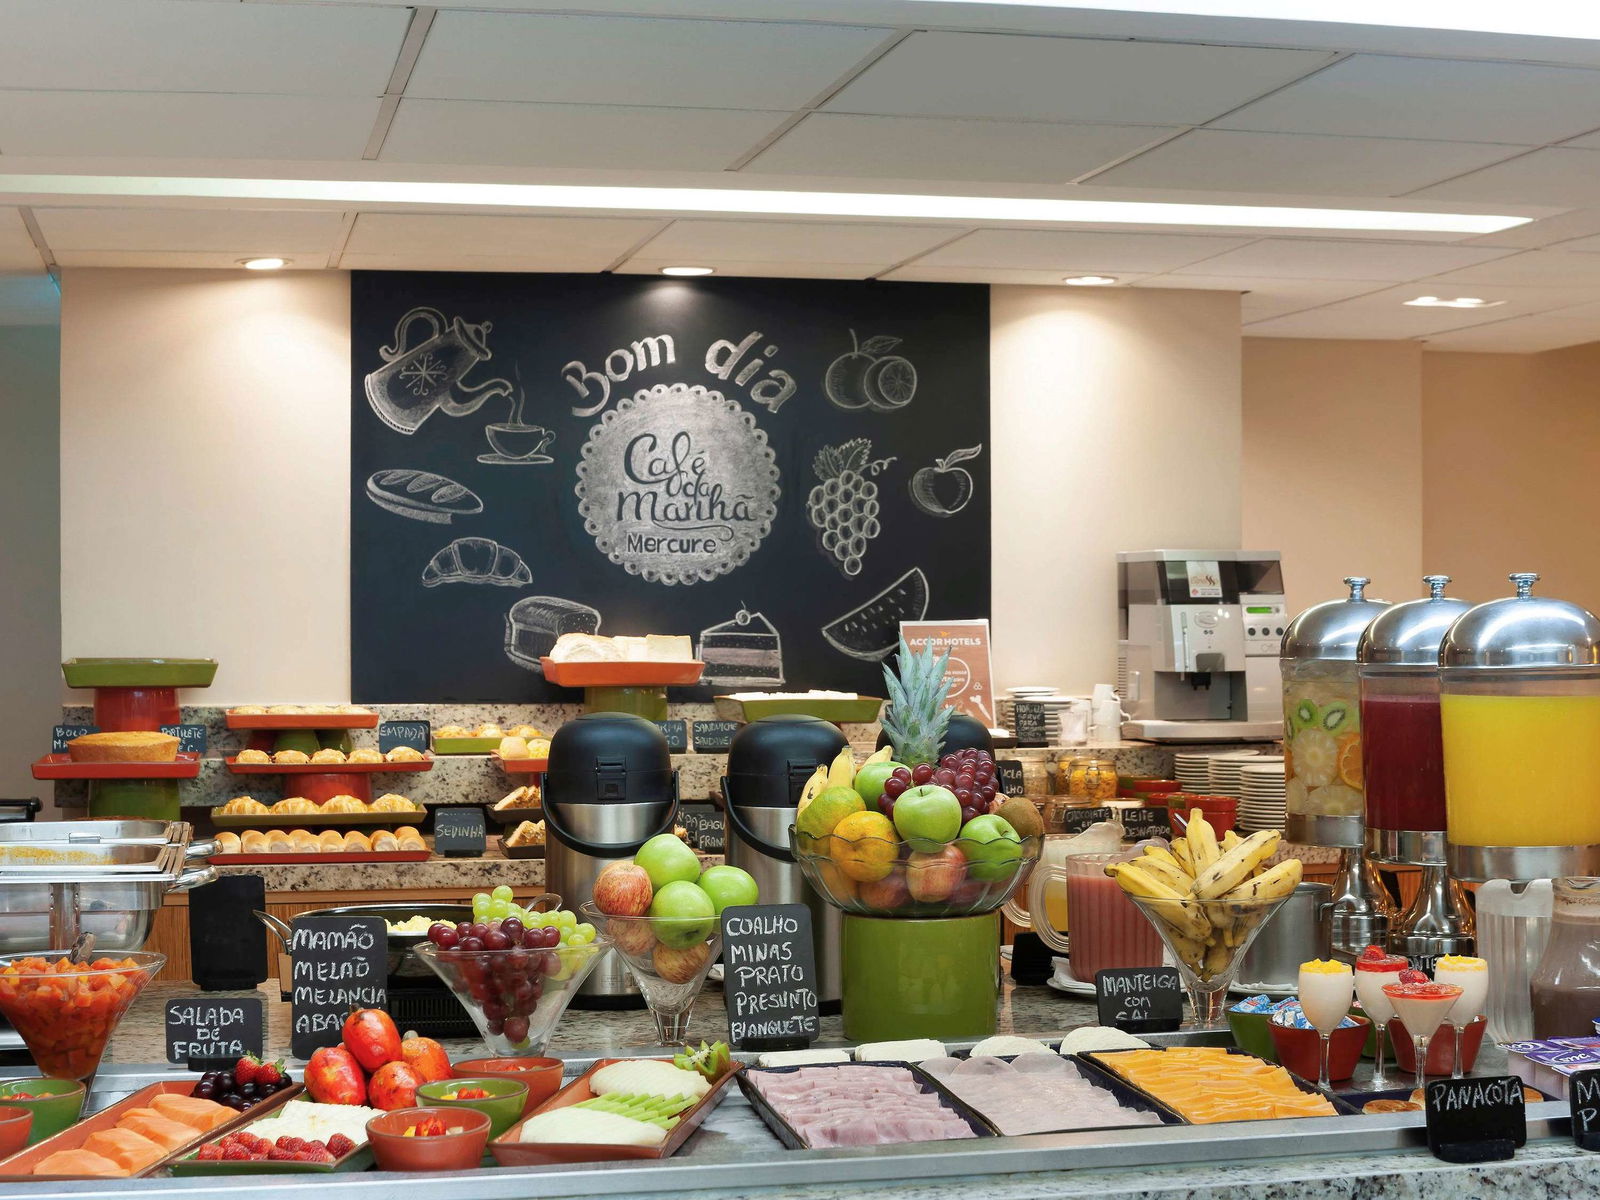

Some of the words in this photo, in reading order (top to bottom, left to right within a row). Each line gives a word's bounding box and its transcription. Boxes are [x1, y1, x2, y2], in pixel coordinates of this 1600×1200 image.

[561, 334, 675, 417] Bom
[705, 331, 797, 413] dia
[624, 431, 705, 497] Café
[627, 533, 716, 554] Mercure
[56, 727, 88, 737] BOLO
[1125, 809, 1154, 822] LEITE
[292, 923, 374, 951] MAMÃO
[726, 915, 798, 937] COALHO
[731, 942, 793, 964] MINAS
[294, 957, 370, 982] MELÃO
[734, 964, 804, 988] PRATO
[294, 985, 388, 1005] MELANCIA
[1102, 974, 1178, 997] MANTEIGA
[734, 988, 817, 1016] PRESUNTO
[1124, 996, 1151, 1008] COM
[168, 1005, 244, 1026] SALADA
[196, 1027, 220, 1041] DE
[173, 1039, 243, 1060] FRUTA
[1431, 1077, 1524, 1112] PANACOTA
